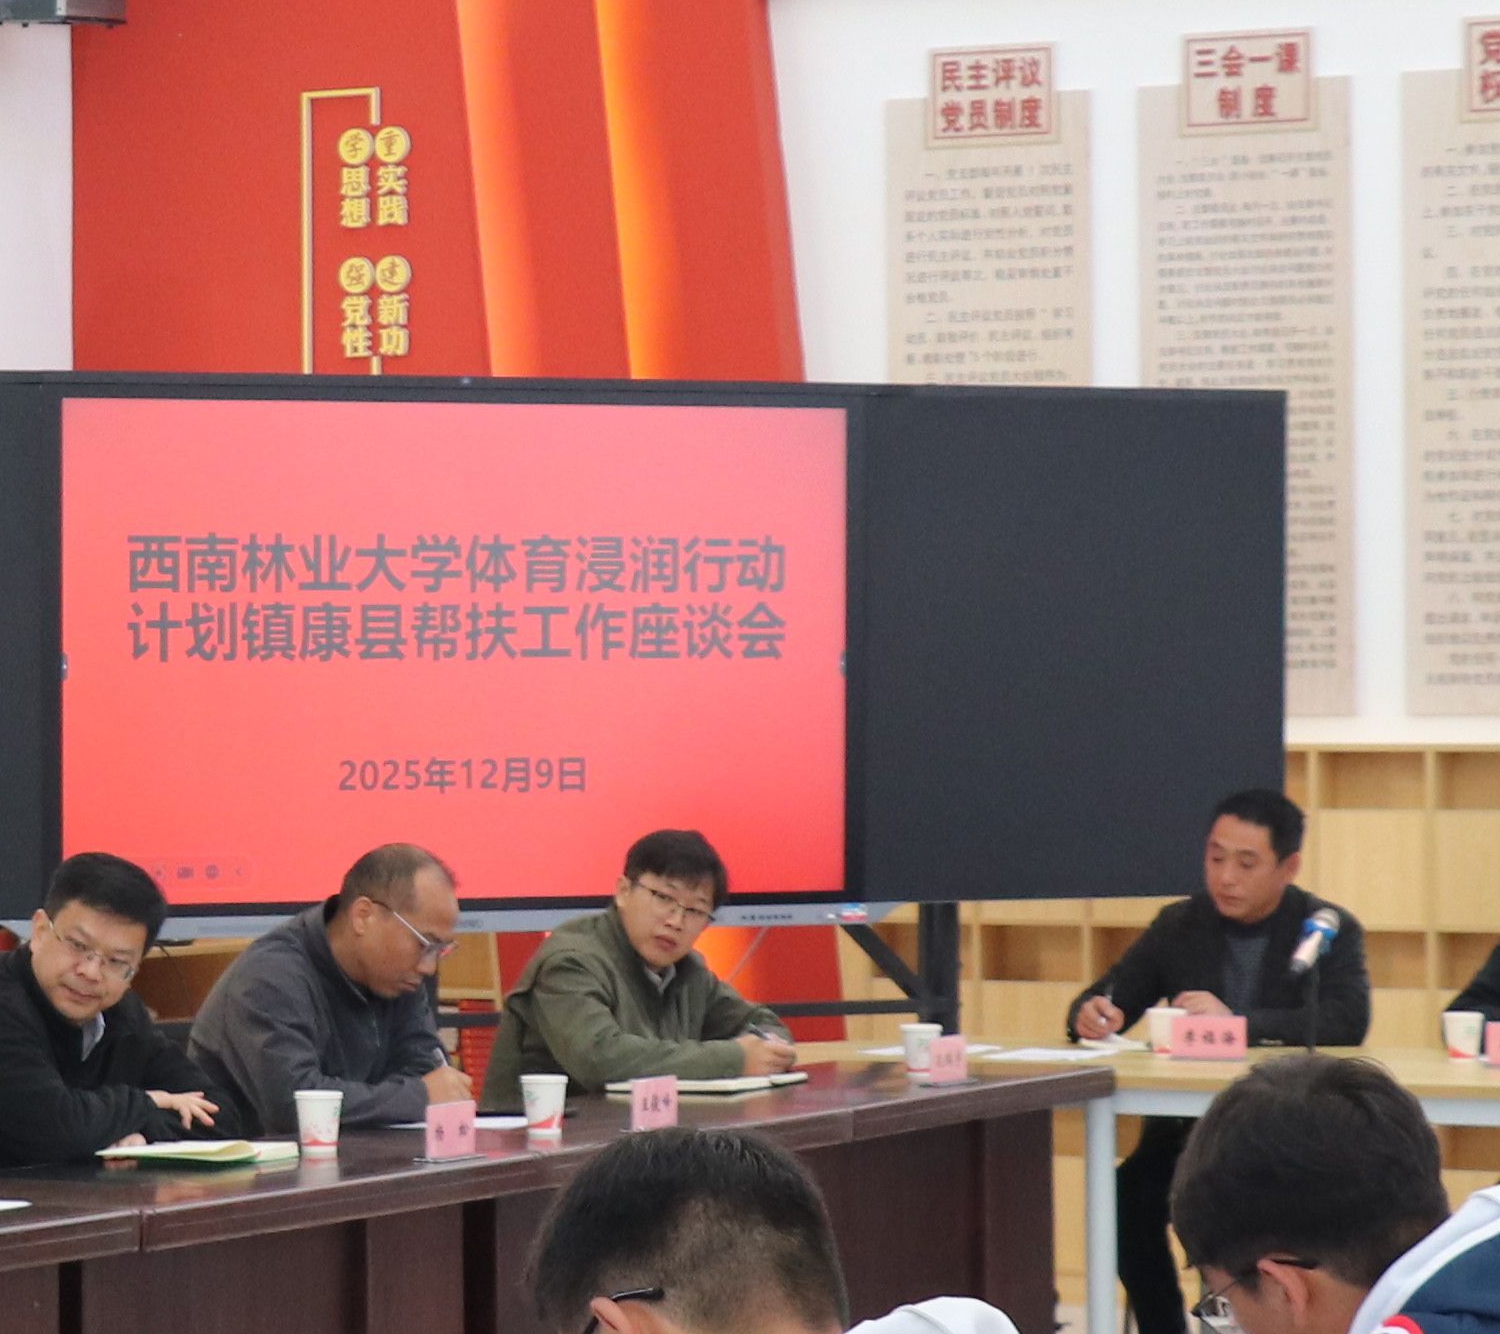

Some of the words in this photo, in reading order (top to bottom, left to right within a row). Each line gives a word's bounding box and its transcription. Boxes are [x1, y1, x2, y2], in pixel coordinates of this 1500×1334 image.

[940, 58, 1043, 91] 民主评议
[1194, 42, 1302, 77] 三会一课
[940, 95, 1043, 133] 党员制度
[1217, 84, 1278, 118] 制度
[337, 128, 374, 228] 学思想
[373, 126, 411, 226] 重实践
[375, 256, 411, 356] 建新功
[127, 534, 786, 594] 西南林业大学体育浸润行动
[127, 602, 786, 662] 计划镇康县帮扶工作座谈会
[339, 757, 587, 794] 2025年12月9日
